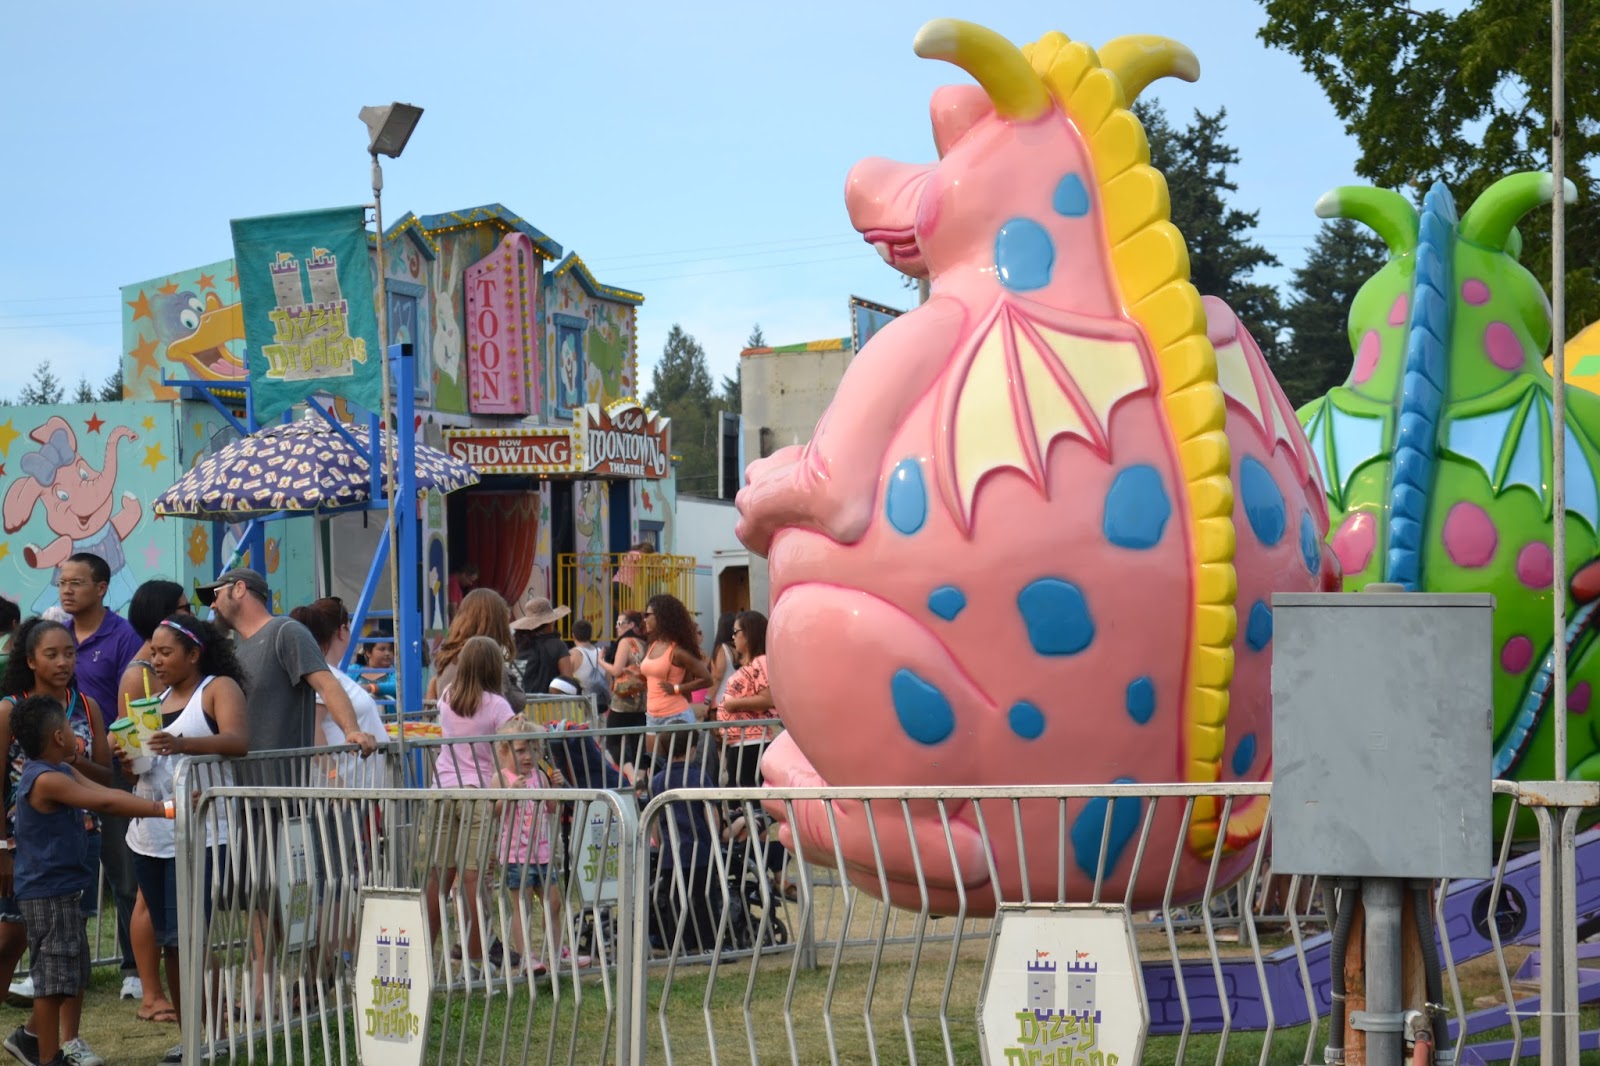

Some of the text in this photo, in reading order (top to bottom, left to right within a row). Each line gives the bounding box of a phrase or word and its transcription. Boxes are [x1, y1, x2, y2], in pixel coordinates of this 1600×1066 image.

[268, 307, 345, 342] Dizzy
[476, 279, 500, 400] TOON
[262, 337, 367, 378] Dragons
[452, 441, 568, 464] SHOWING
[498, 439, 521, 447] NOW
[588, 428, 666, 476] TOONTOWN
[608, 462, 645, 475] THEATRE
[371, 978, 409, 1013] Dizzy
[365, 1008, 419, 1038] Dragons
[1015, 1011, 1095, 1053] Dizzy
